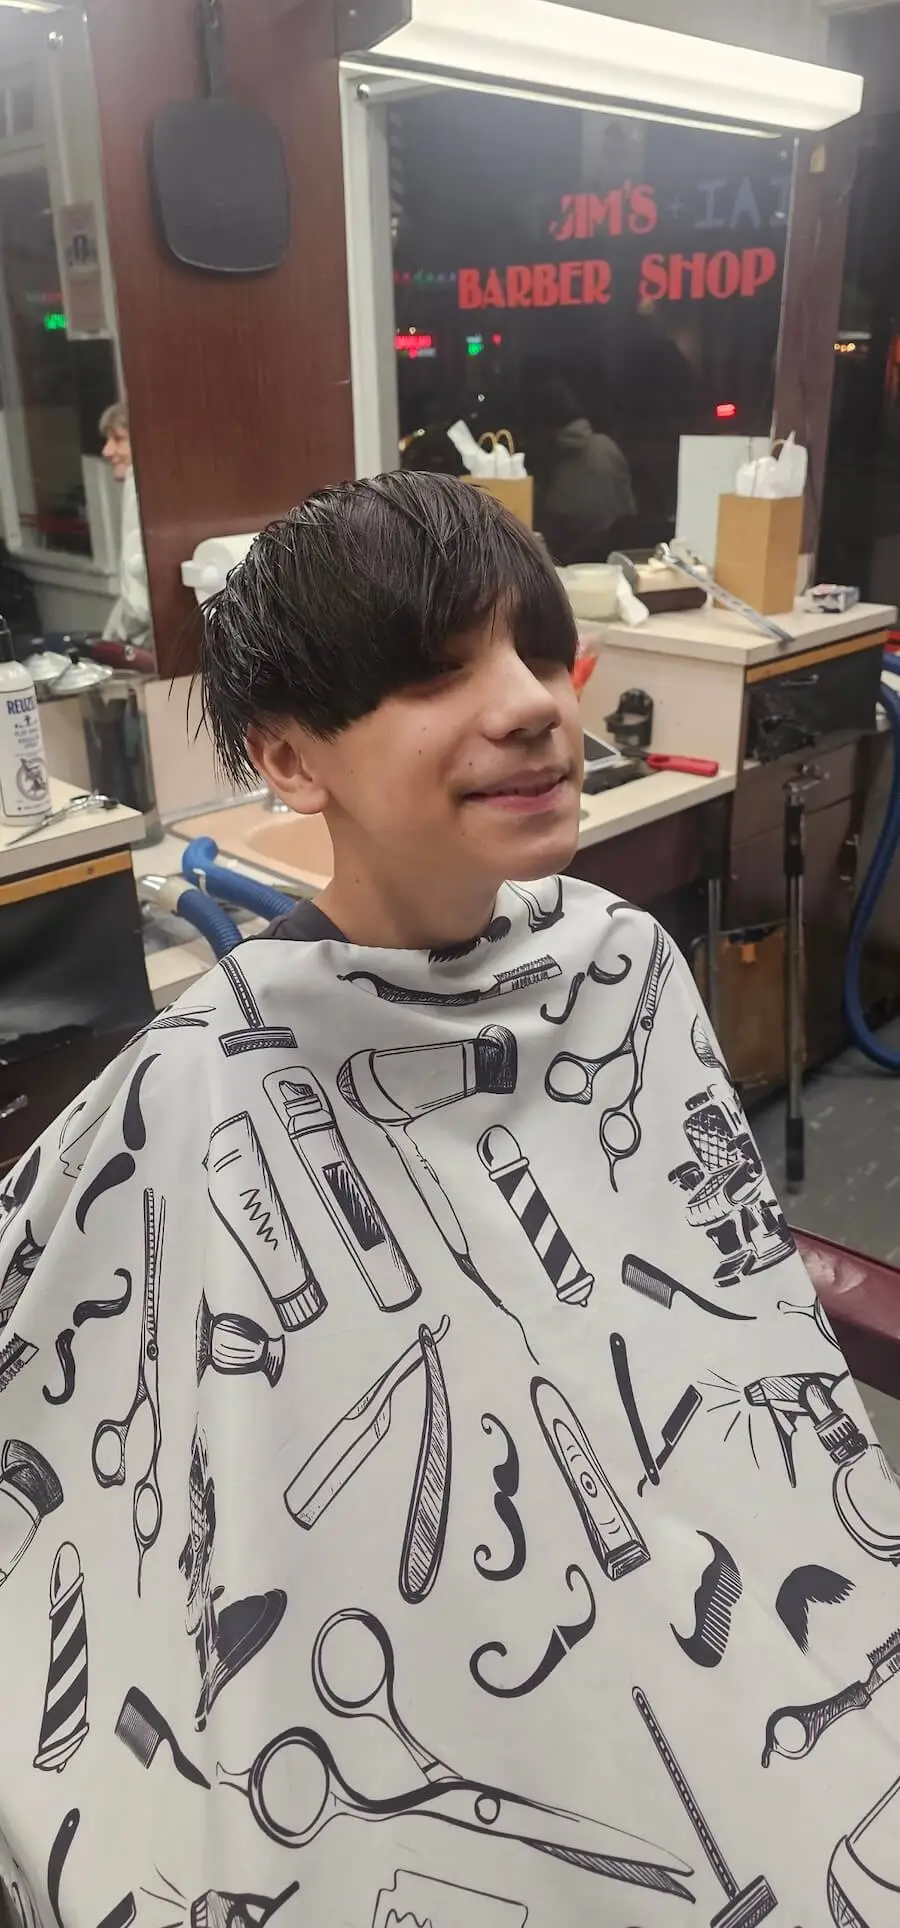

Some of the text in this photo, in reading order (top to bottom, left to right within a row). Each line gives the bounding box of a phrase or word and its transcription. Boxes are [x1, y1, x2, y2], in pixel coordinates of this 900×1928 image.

[548, 180, 658, 241] JIM'S
[458, 247, 777, 309] BARBER SHOP
